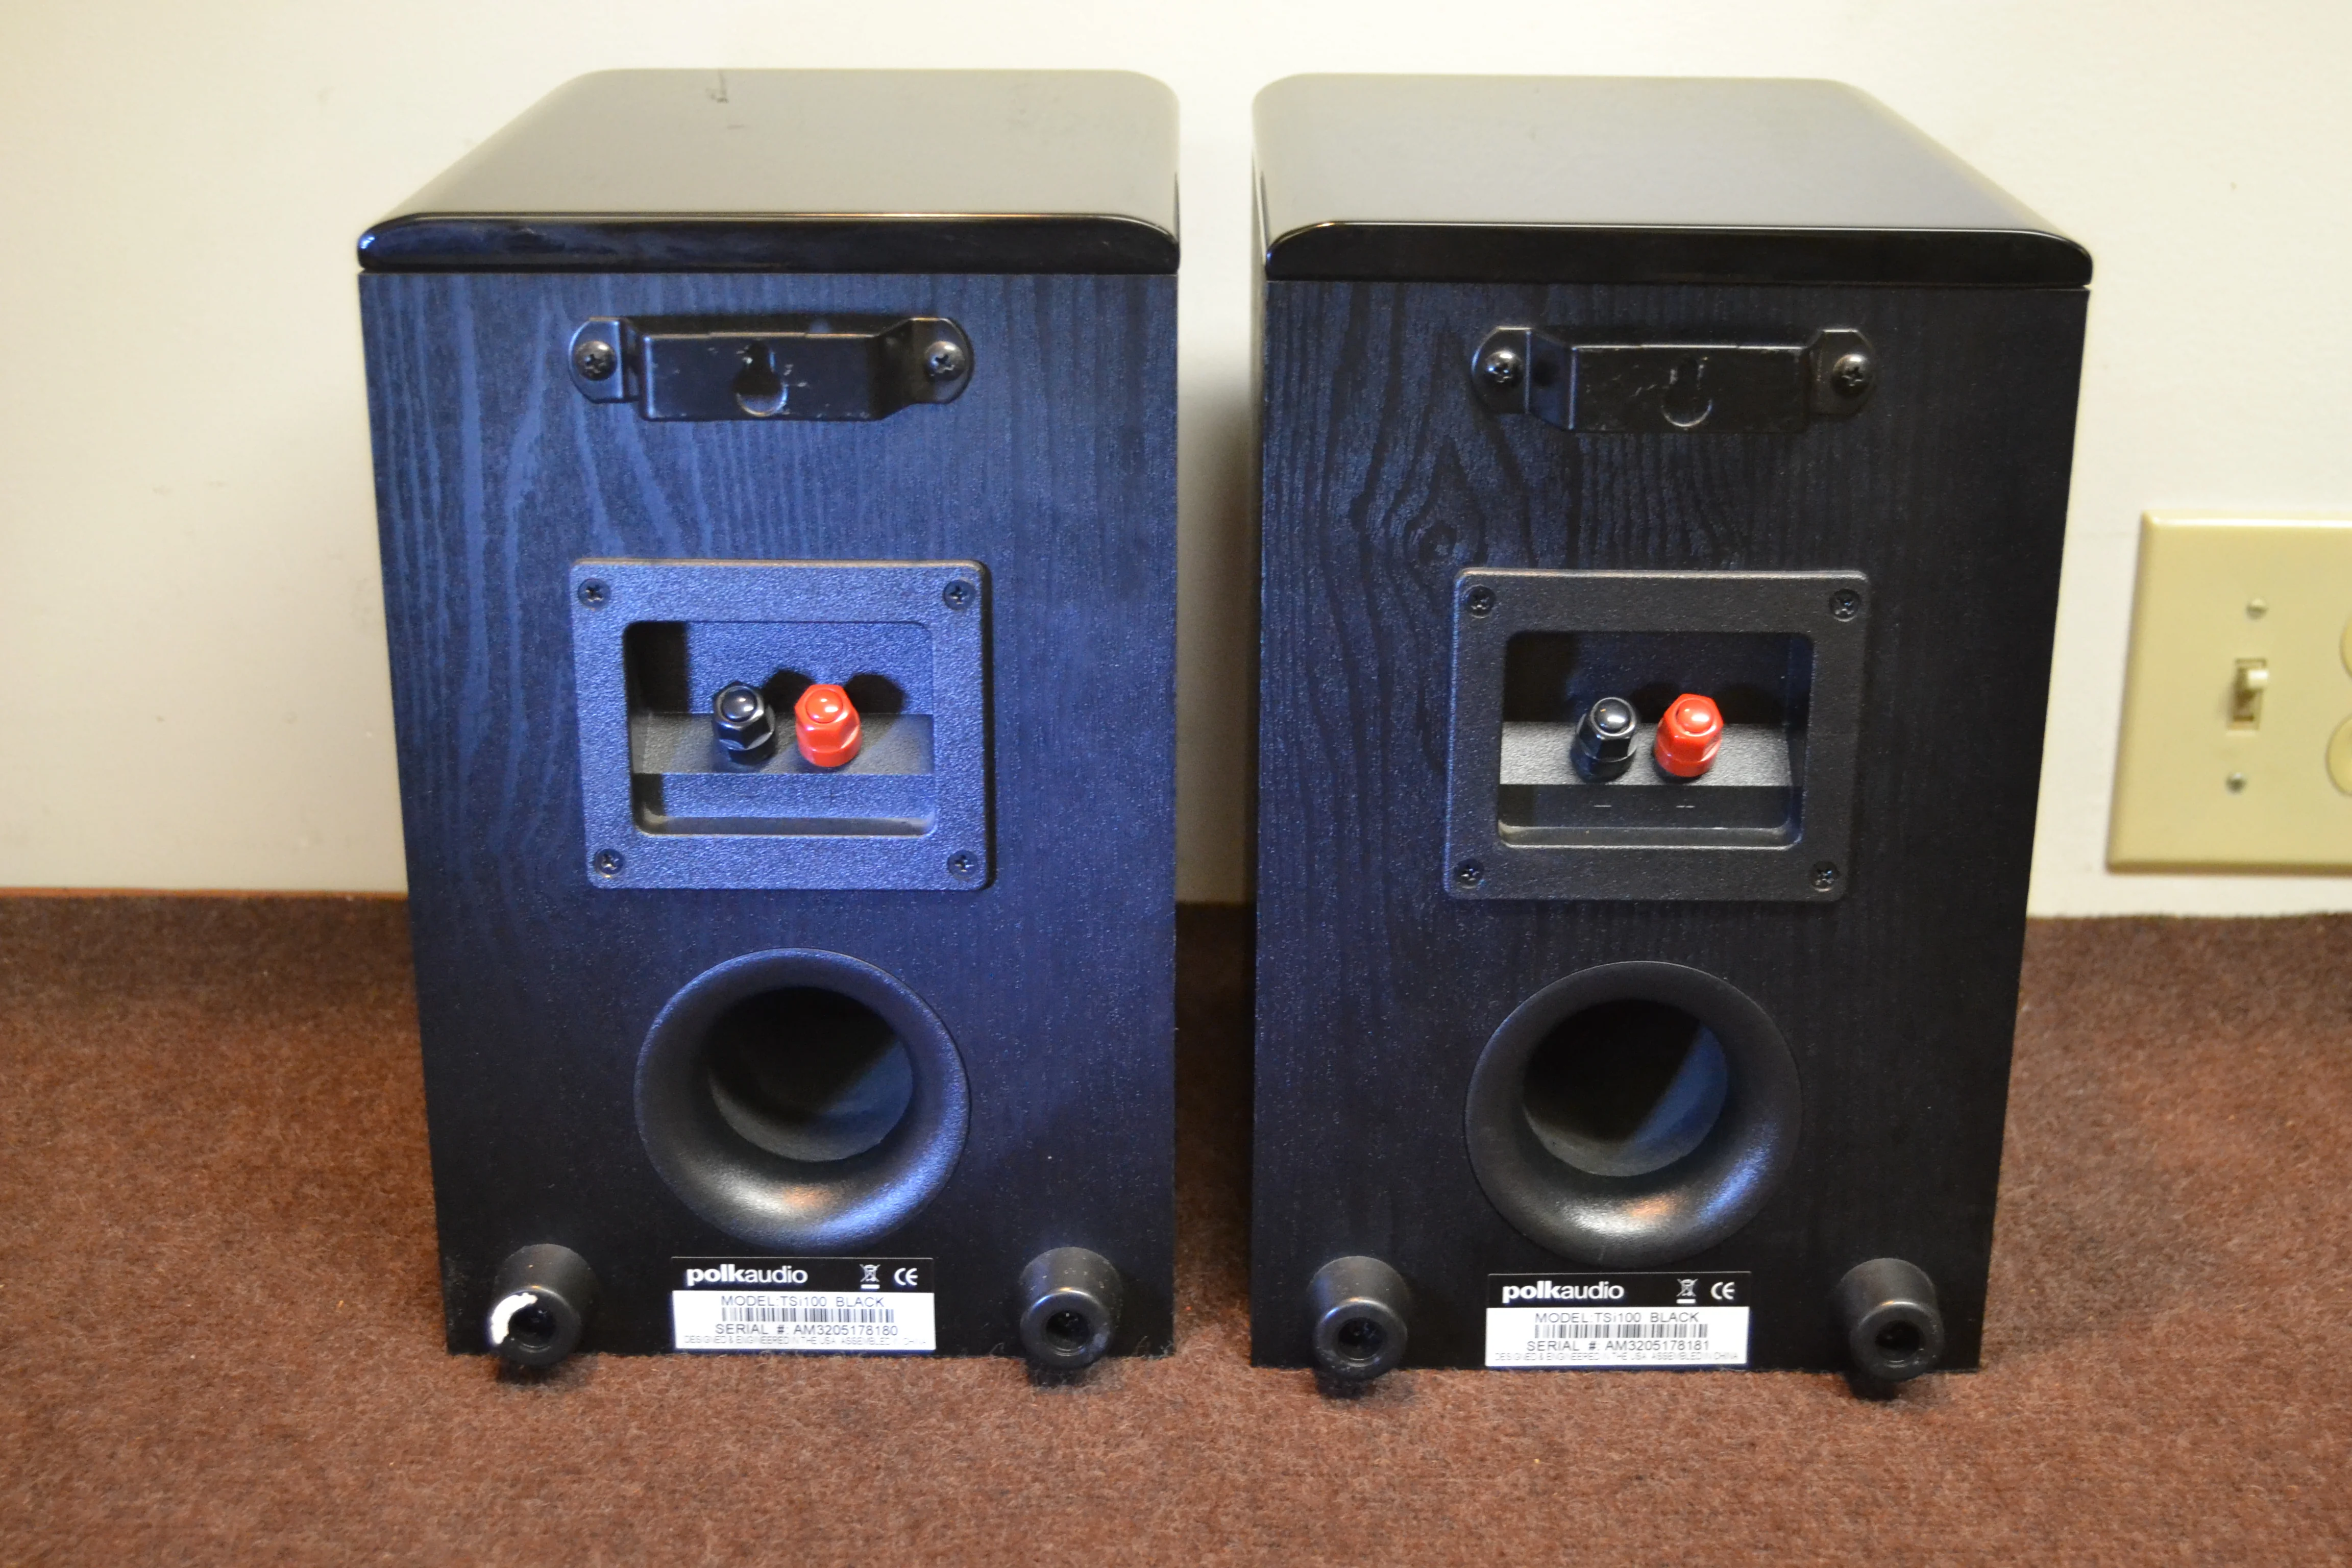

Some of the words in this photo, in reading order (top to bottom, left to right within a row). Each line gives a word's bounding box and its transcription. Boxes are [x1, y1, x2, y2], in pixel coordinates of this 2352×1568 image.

[686, 1264, 808, 1286] polkaudio
[1502, 1280, 1625, 1304] polkaudio
[836, 1297, 885, 1307] BLACK
[1650, 1312, 1700, 1322] BLACK
[715, 1324, 769, 1335] SERIAL
[793, 1325, 899, 1336] AM3205178180
[1527, 1340, 1580, 1351] SERIAL
[1604, 1340, 1709, 1351] AM3205178181
